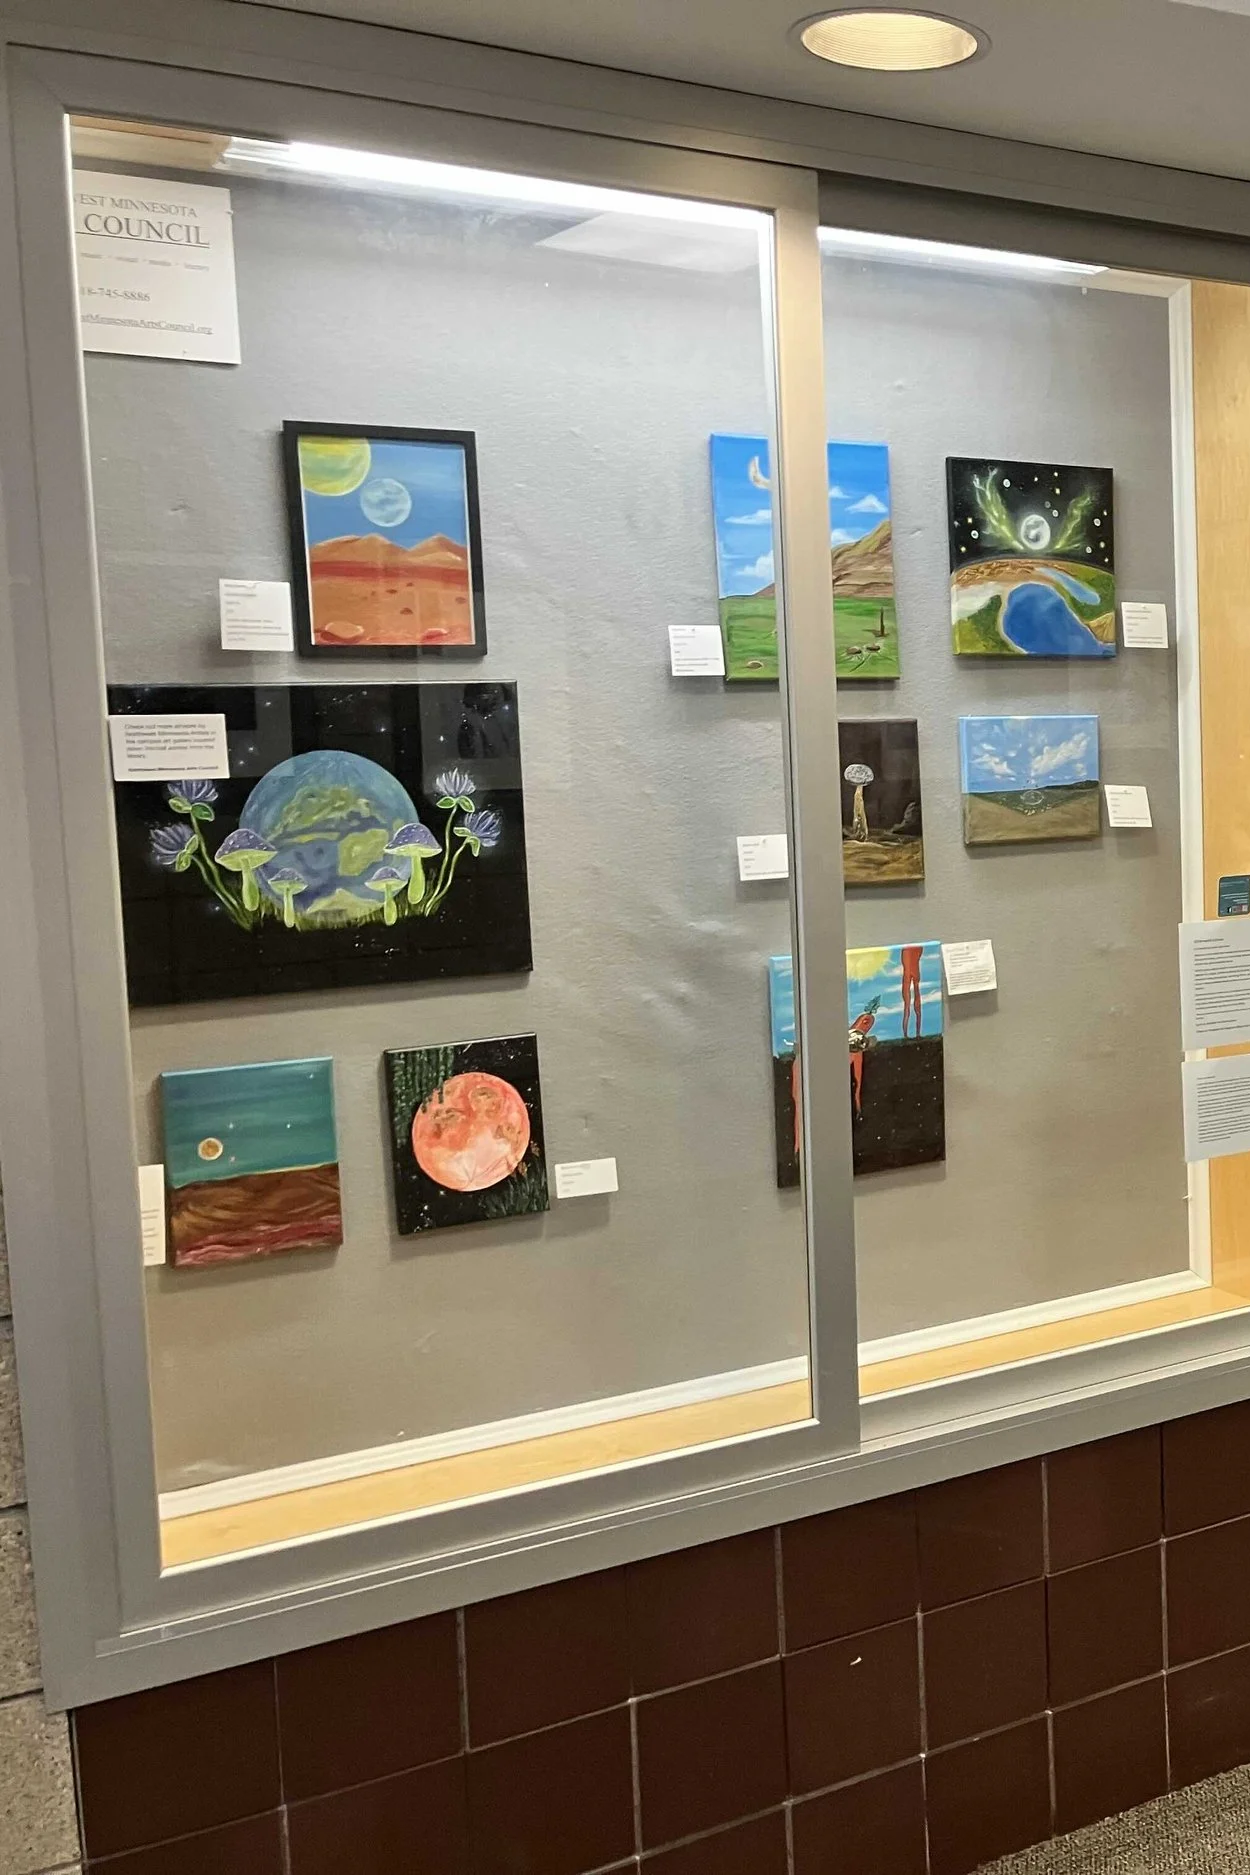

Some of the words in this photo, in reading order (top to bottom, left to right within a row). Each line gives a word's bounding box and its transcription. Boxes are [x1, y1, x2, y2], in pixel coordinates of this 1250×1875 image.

[74, 193, 106, 207] EST
[110, 197, 198, 218] MINNESOTA
[84, 213, 210, 245] COUNCIL
